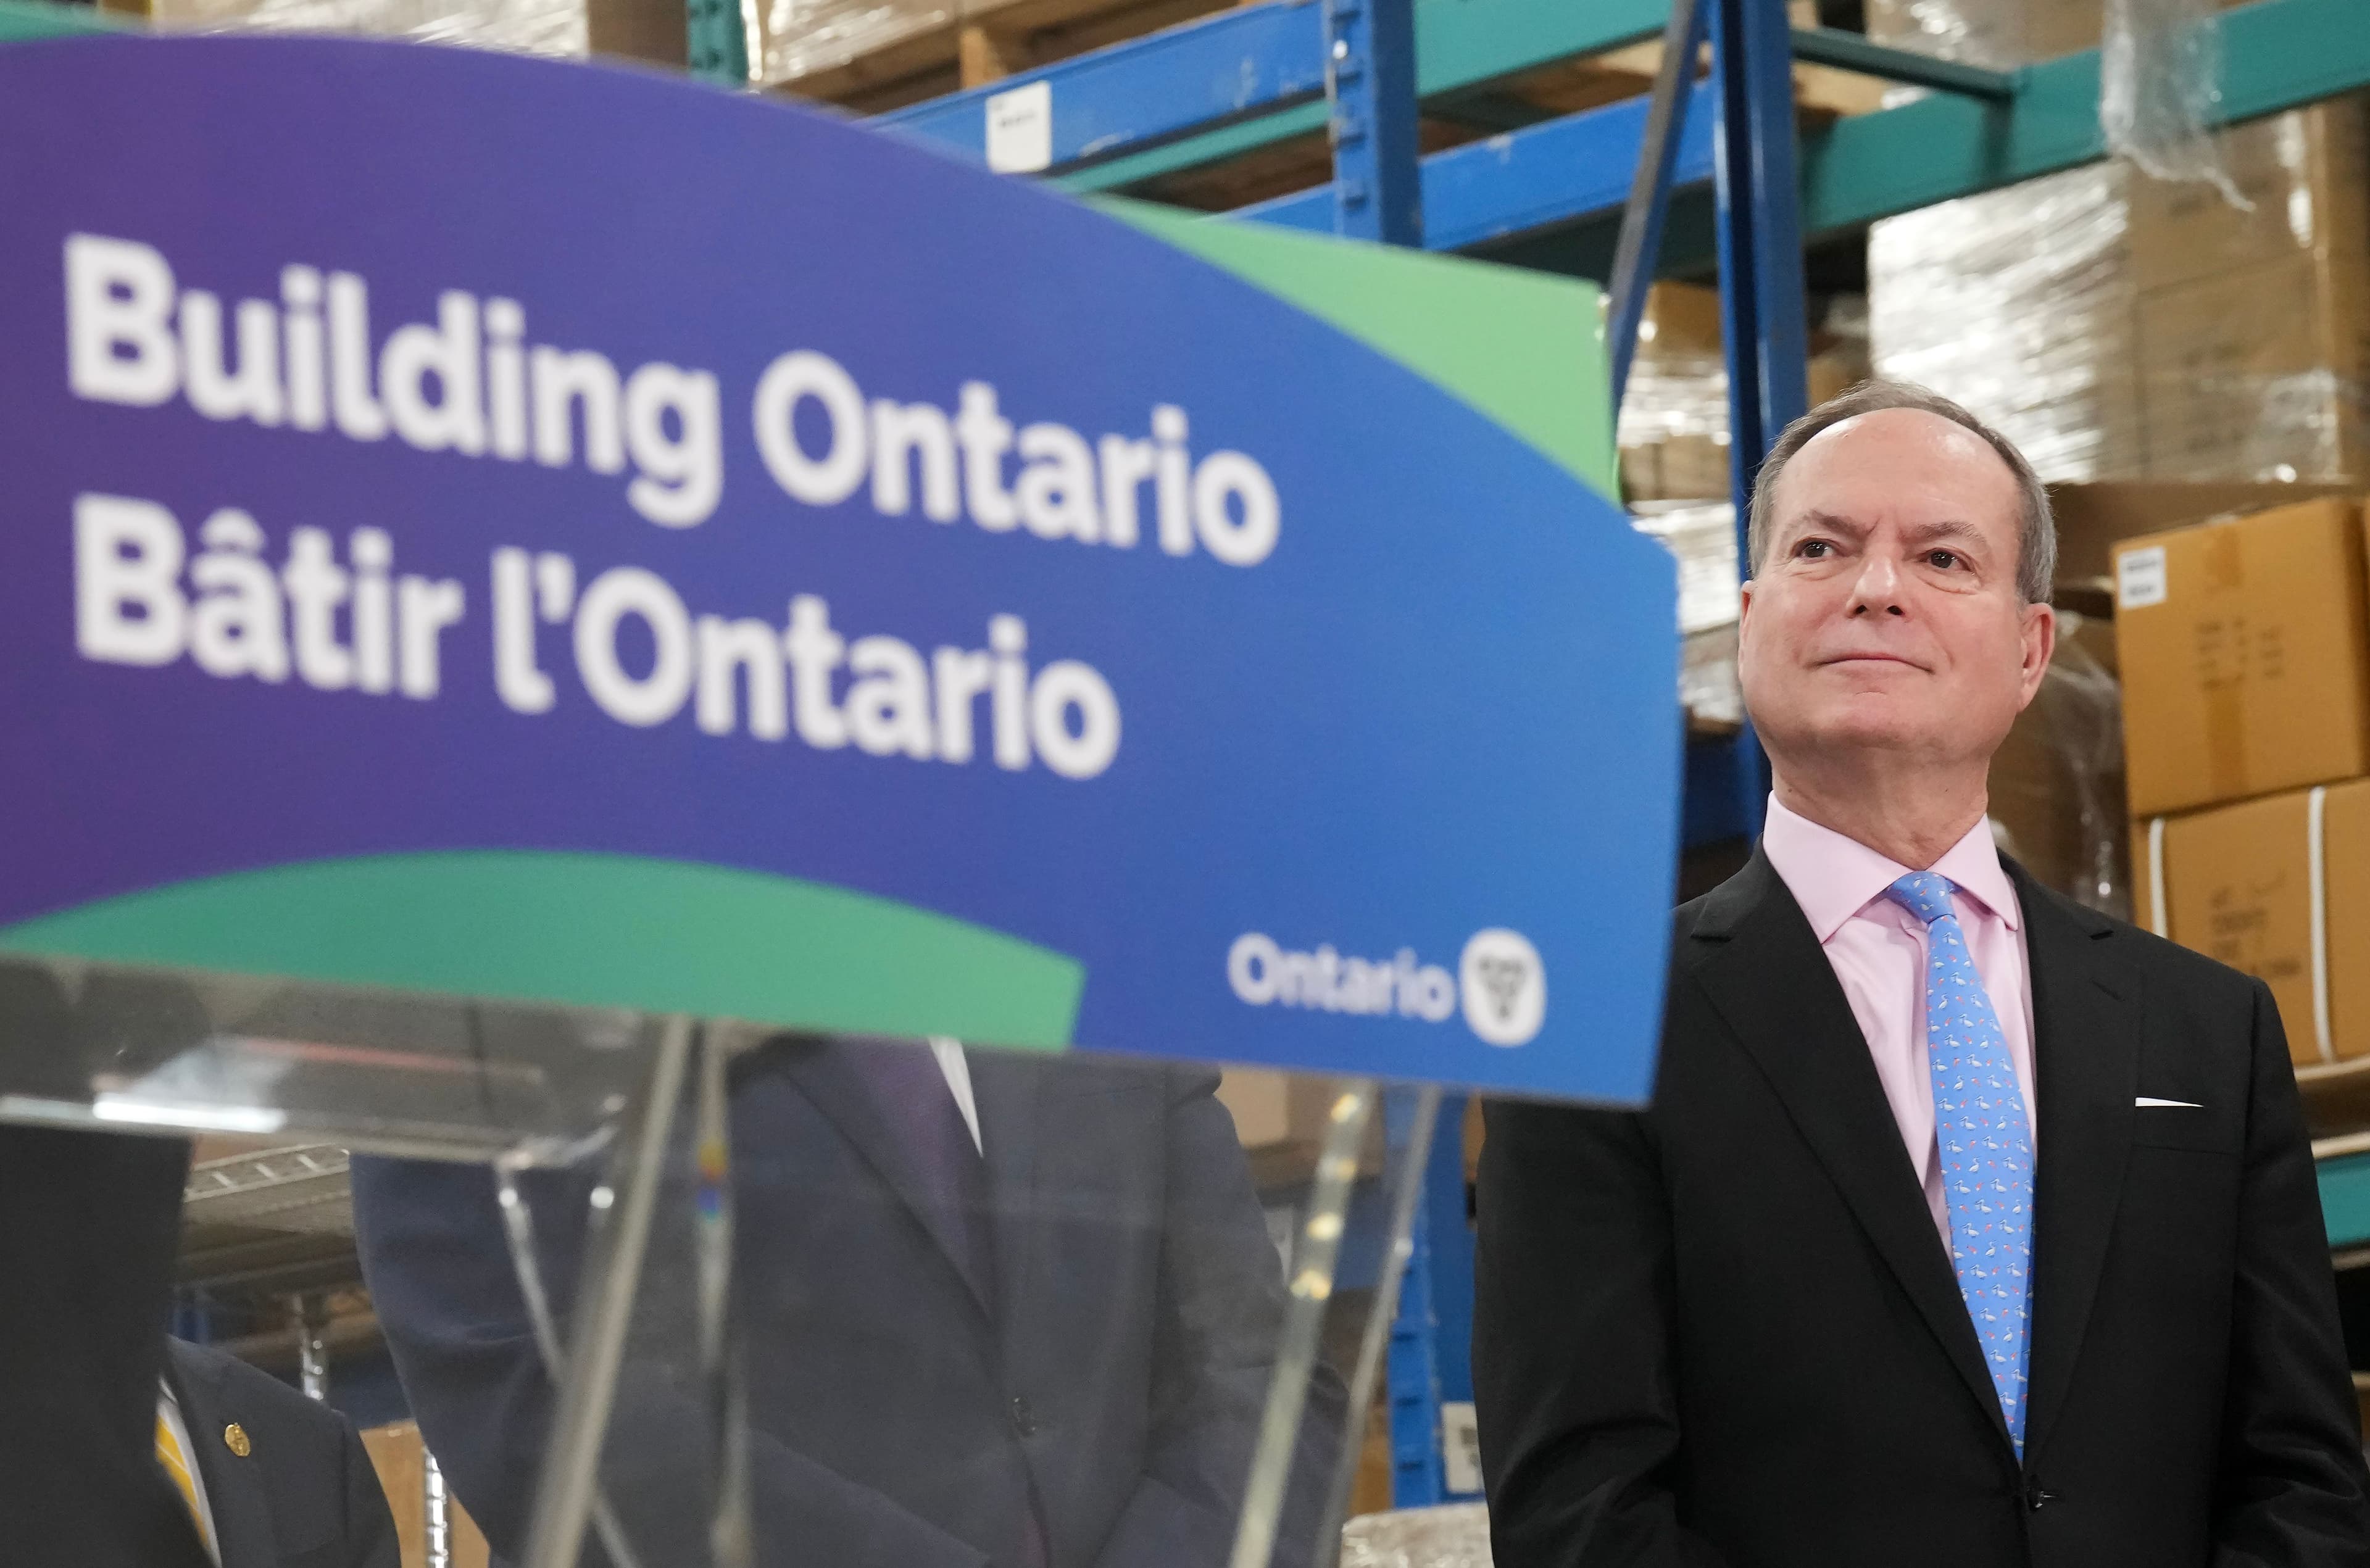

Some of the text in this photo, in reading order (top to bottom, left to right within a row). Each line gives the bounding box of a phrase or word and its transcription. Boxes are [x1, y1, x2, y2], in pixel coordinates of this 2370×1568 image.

[65, 233, 1280, 566] Building Ontario
[73, 494, 1121, 779] Bâtir l'Ontario
[1228, 934, 1455, 1023] Ontario
